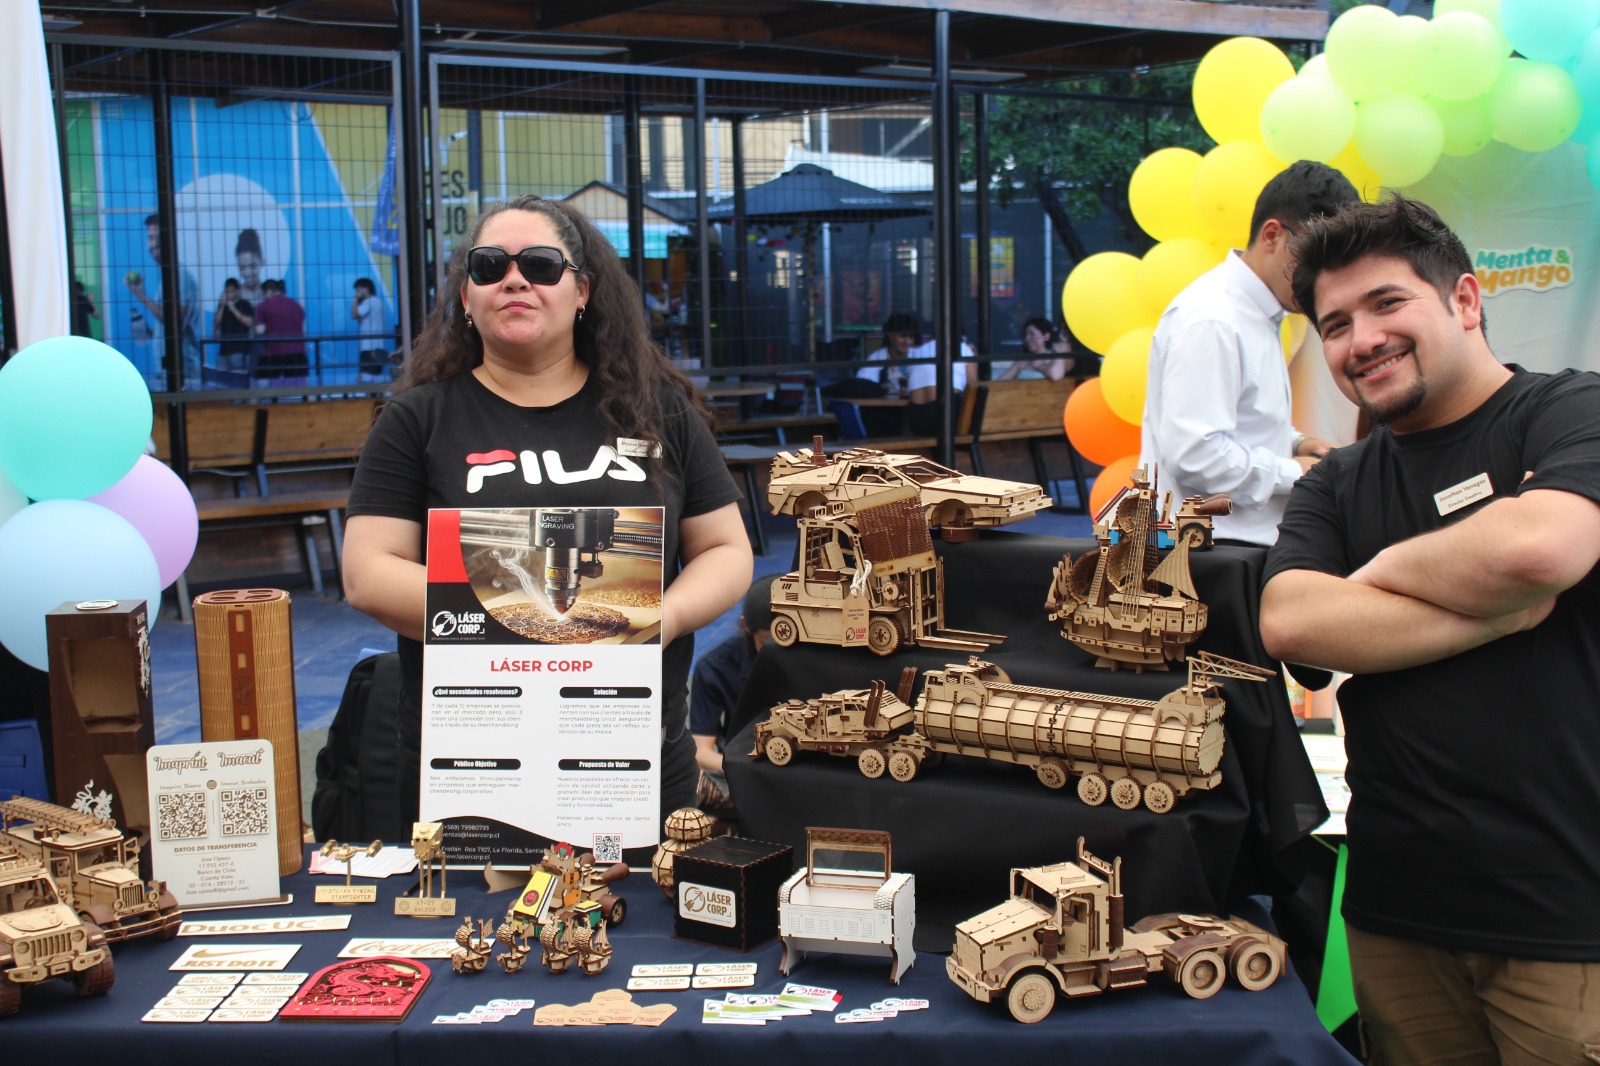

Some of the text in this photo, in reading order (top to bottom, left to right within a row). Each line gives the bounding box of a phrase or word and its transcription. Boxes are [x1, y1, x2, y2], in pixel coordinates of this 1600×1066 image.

[1475, 246, 1570, 270] Menta &
[1475, 264, 1571, 294] Mango
[466, 444, 646, 494] FILA
[542, 515, 564, 523] LASER
[458, 611, 486, 623] LÁSER
[458, 624, 480, 634] CORP
[490, 657, 593, 672] LÁSER CORP
[448, 688, 483, 696] necesidades
[593, 688, 618, 696] Solución
[153, 750, 208, 775] Imaprint
[453, 760, 497, 768] Público Objetivo
[207, 842, 257, 850] TRANSFERENCIA
[707, 891, 731, 906] LÁSER
[707, 904, 727, 916] CORP
[272, 919, 317, 930] UC
[180, 960, 225, 968] JUST
